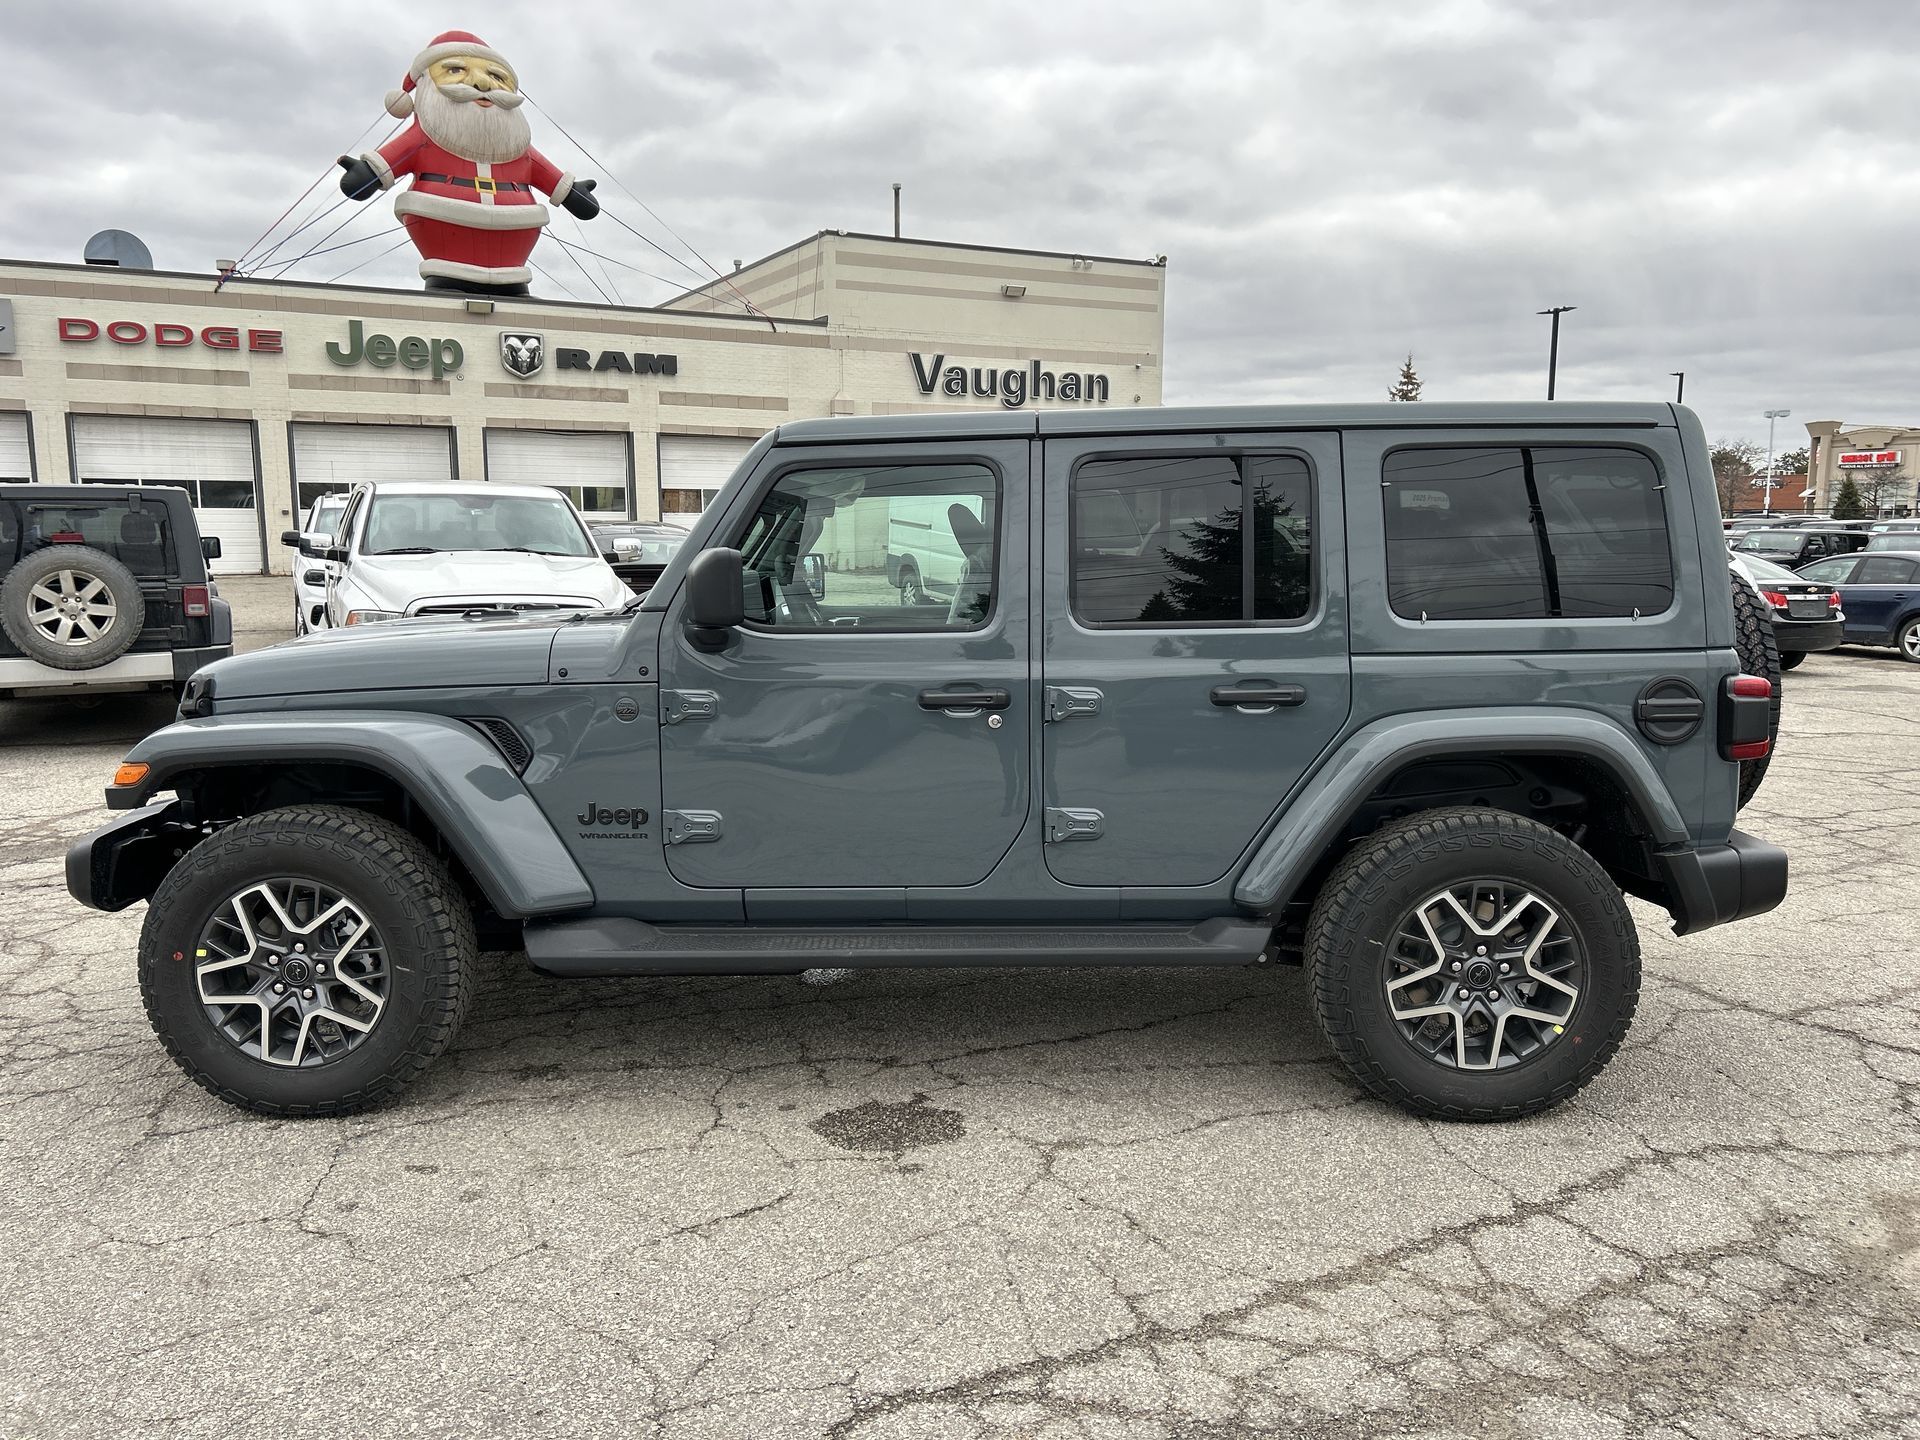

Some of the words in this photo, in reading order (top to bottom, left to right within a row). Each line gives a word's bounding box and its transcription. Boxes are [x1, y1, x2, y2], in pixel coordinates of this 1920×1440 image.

[57, 317, 283, 353] DODGE
[325, 319, 464, 380] Jeep
[556, 347, 678, 375] RAM
[908, 352, 1109, 408] Vaughan
[577, 801, 649, 829] Jeep
